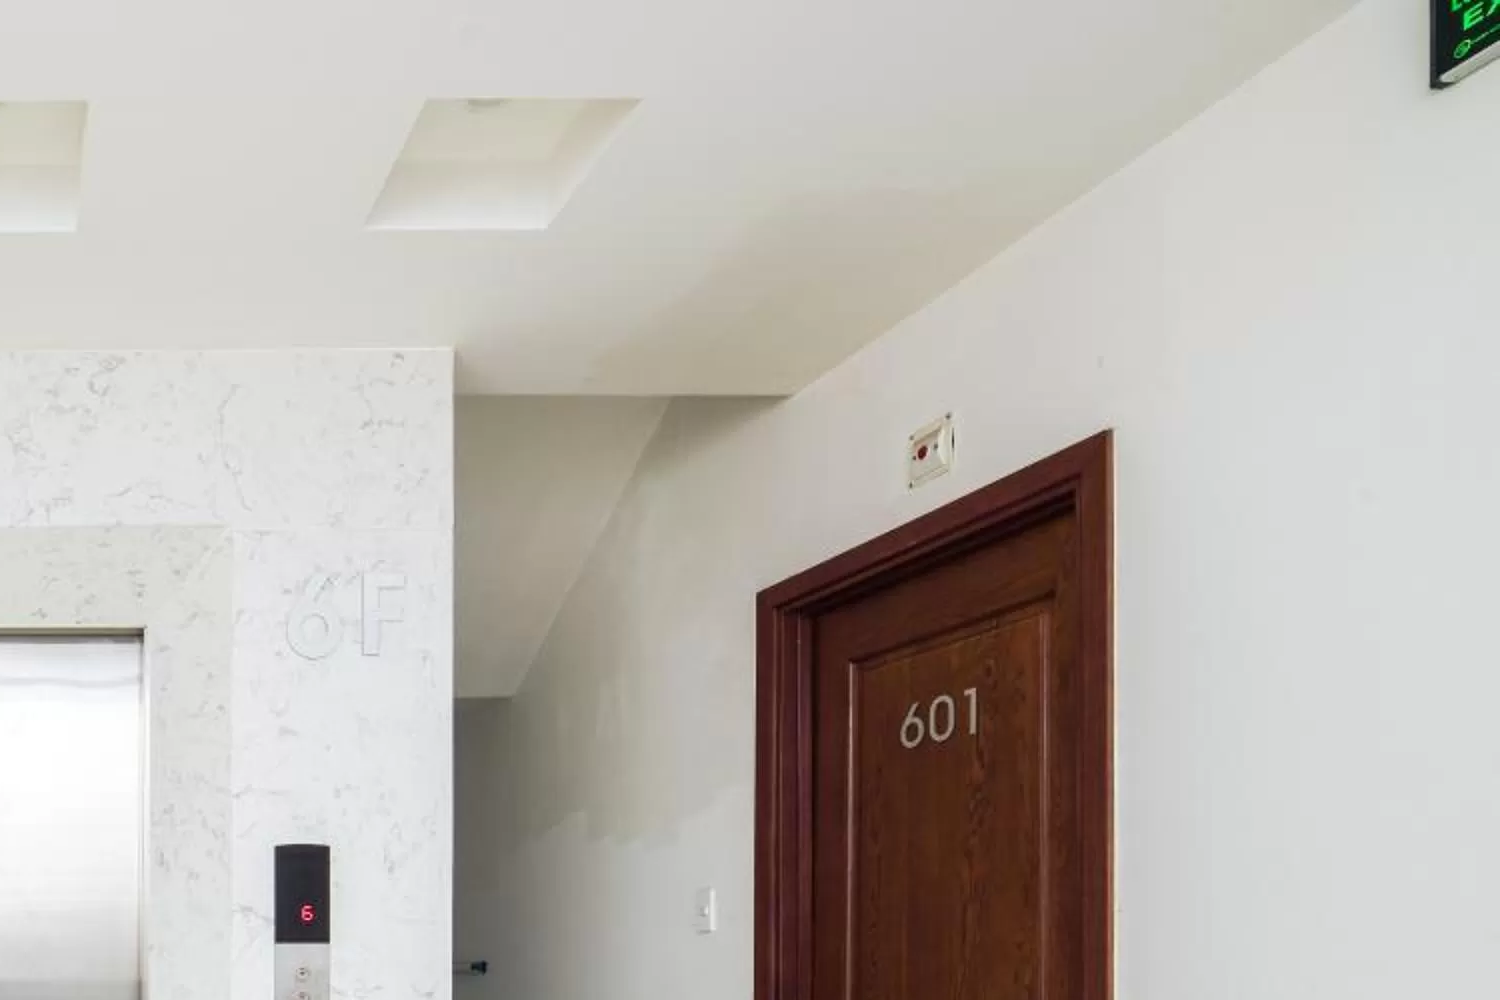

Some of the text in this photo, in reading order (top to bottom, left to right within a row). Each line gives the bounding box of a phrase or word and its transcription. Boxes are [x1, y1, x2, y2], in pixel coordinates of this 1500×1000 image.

[286, 567, 406, 661] 6F
[900, 687, 977, 749] 601
[301, 905, 314, 921] 6
